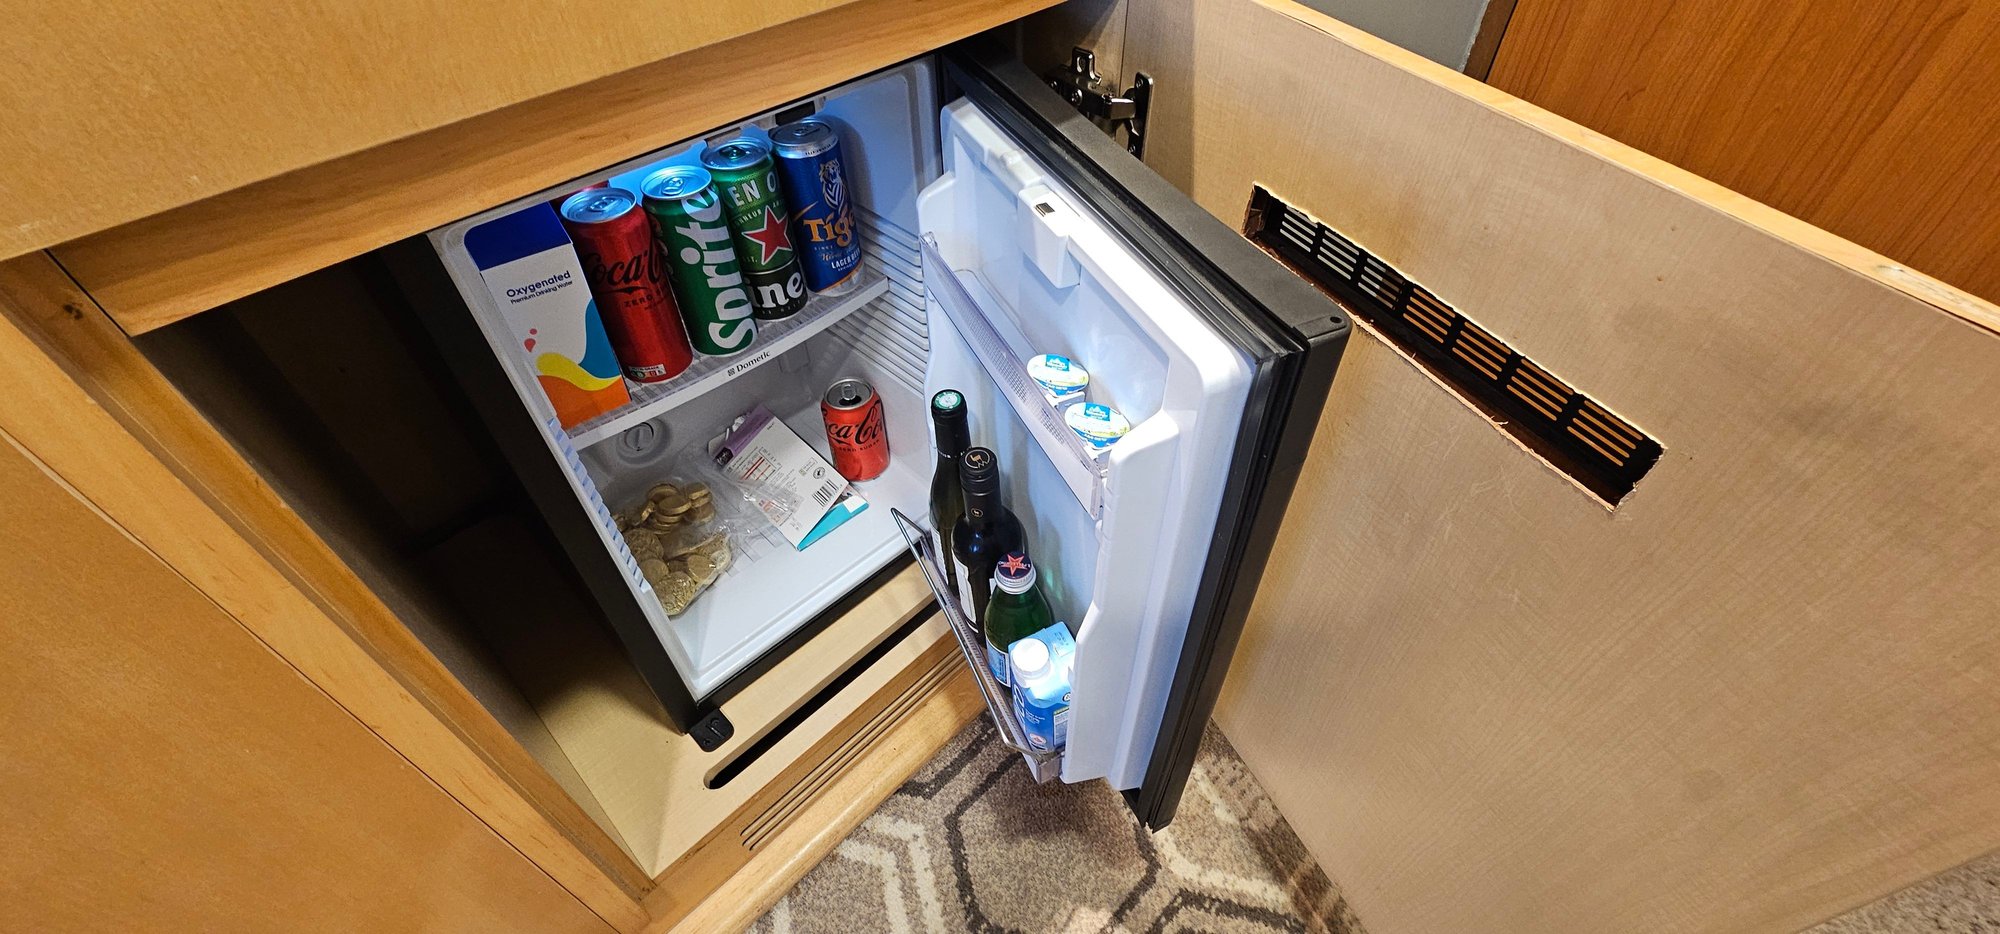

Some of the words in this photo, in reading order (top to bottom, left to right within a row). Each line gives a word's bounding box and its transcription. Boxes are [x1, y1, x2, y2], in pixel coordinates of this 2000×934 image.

[675, 187, 757, 349] Sprite
[506, 270, 571, 297] Oxygenated
[510, 294, 536, 304] Premium
[536, 286, 558, 297] Drinking
[556, 280, 573, 290] Water
[736, 351, 770, 372] Dometic
